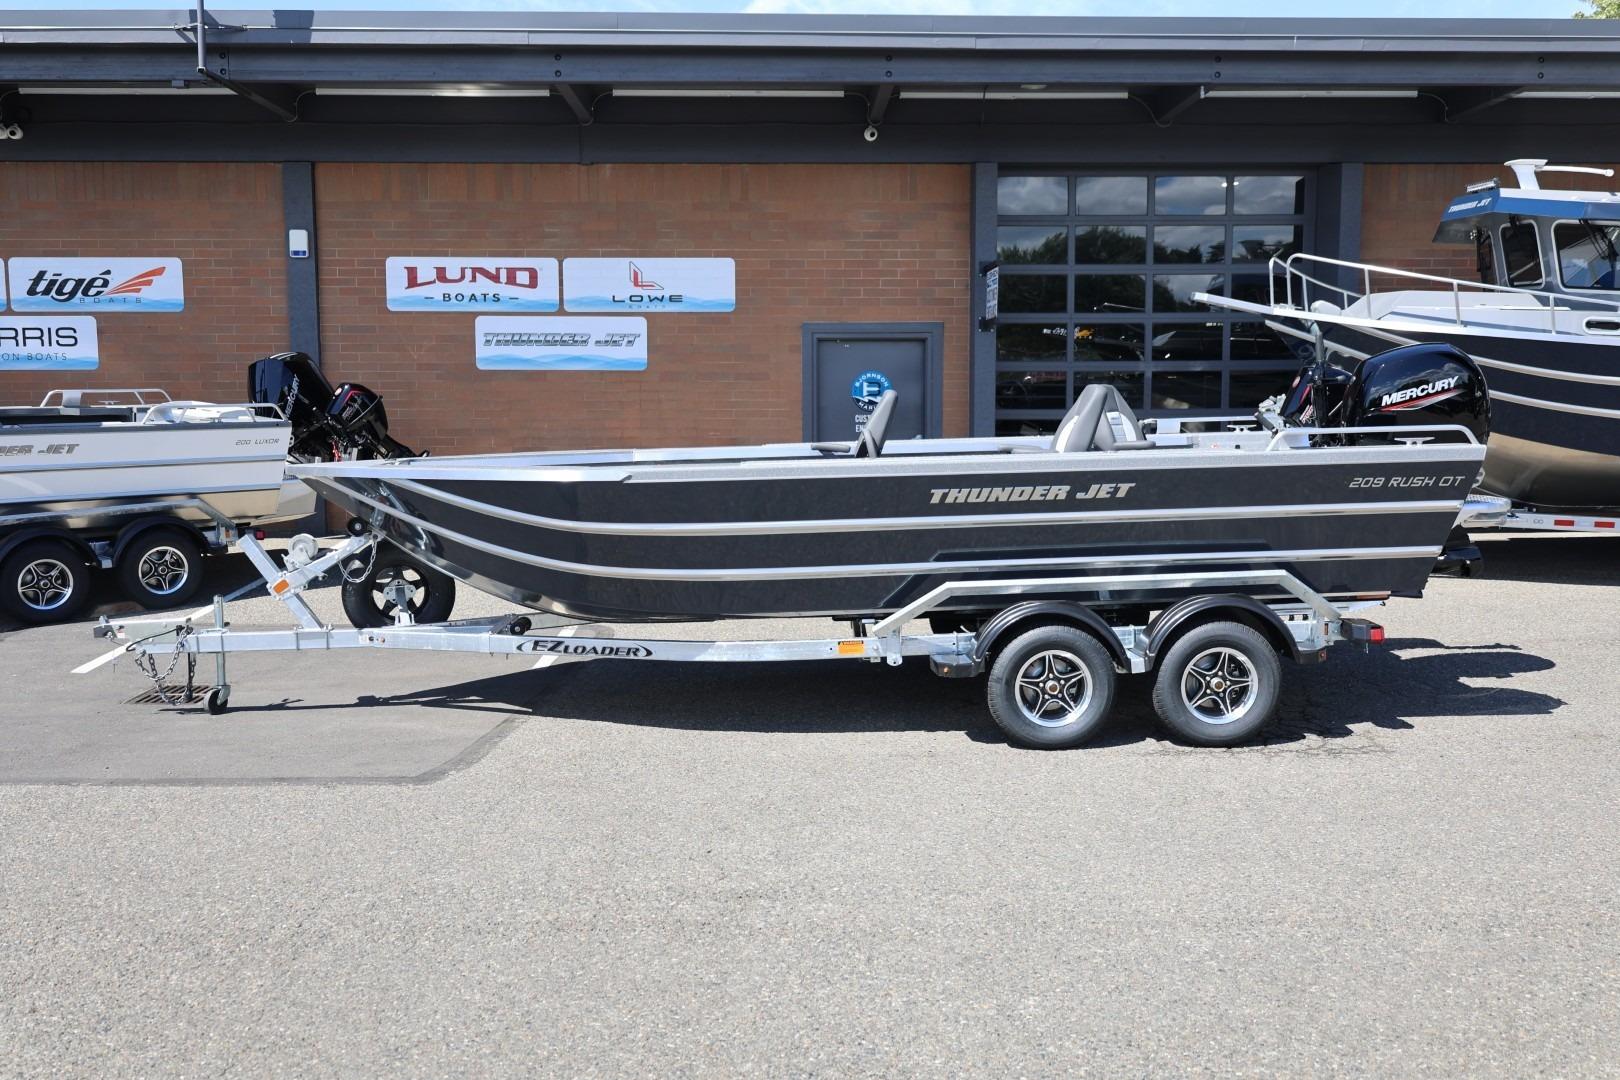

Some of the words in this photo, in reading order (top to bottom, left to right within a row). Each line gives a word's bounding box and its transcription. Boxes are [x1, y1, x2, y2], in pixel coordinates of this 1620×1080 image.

[404, 266, 538, 290] LUND
[26, 269, 112, 302] tigé
[442, 292, 501, 303] BOATS
[612, 294, 683, 303] LOWE
[483, 332, 591, 347] THUNDER
[594, 332, 641, 347] JET
[27, 352, 68, 361] BOATS
[1381, 375, 1460, 407] MERCURY
[37, 443, 80, 455] JET
[1349, 477, 1385, 488] 209
[1388, 476, 1436, 488] RUSH
[929, 485, 1071, 504] THUNDER
[1075, 482, 1137, 500] JET
